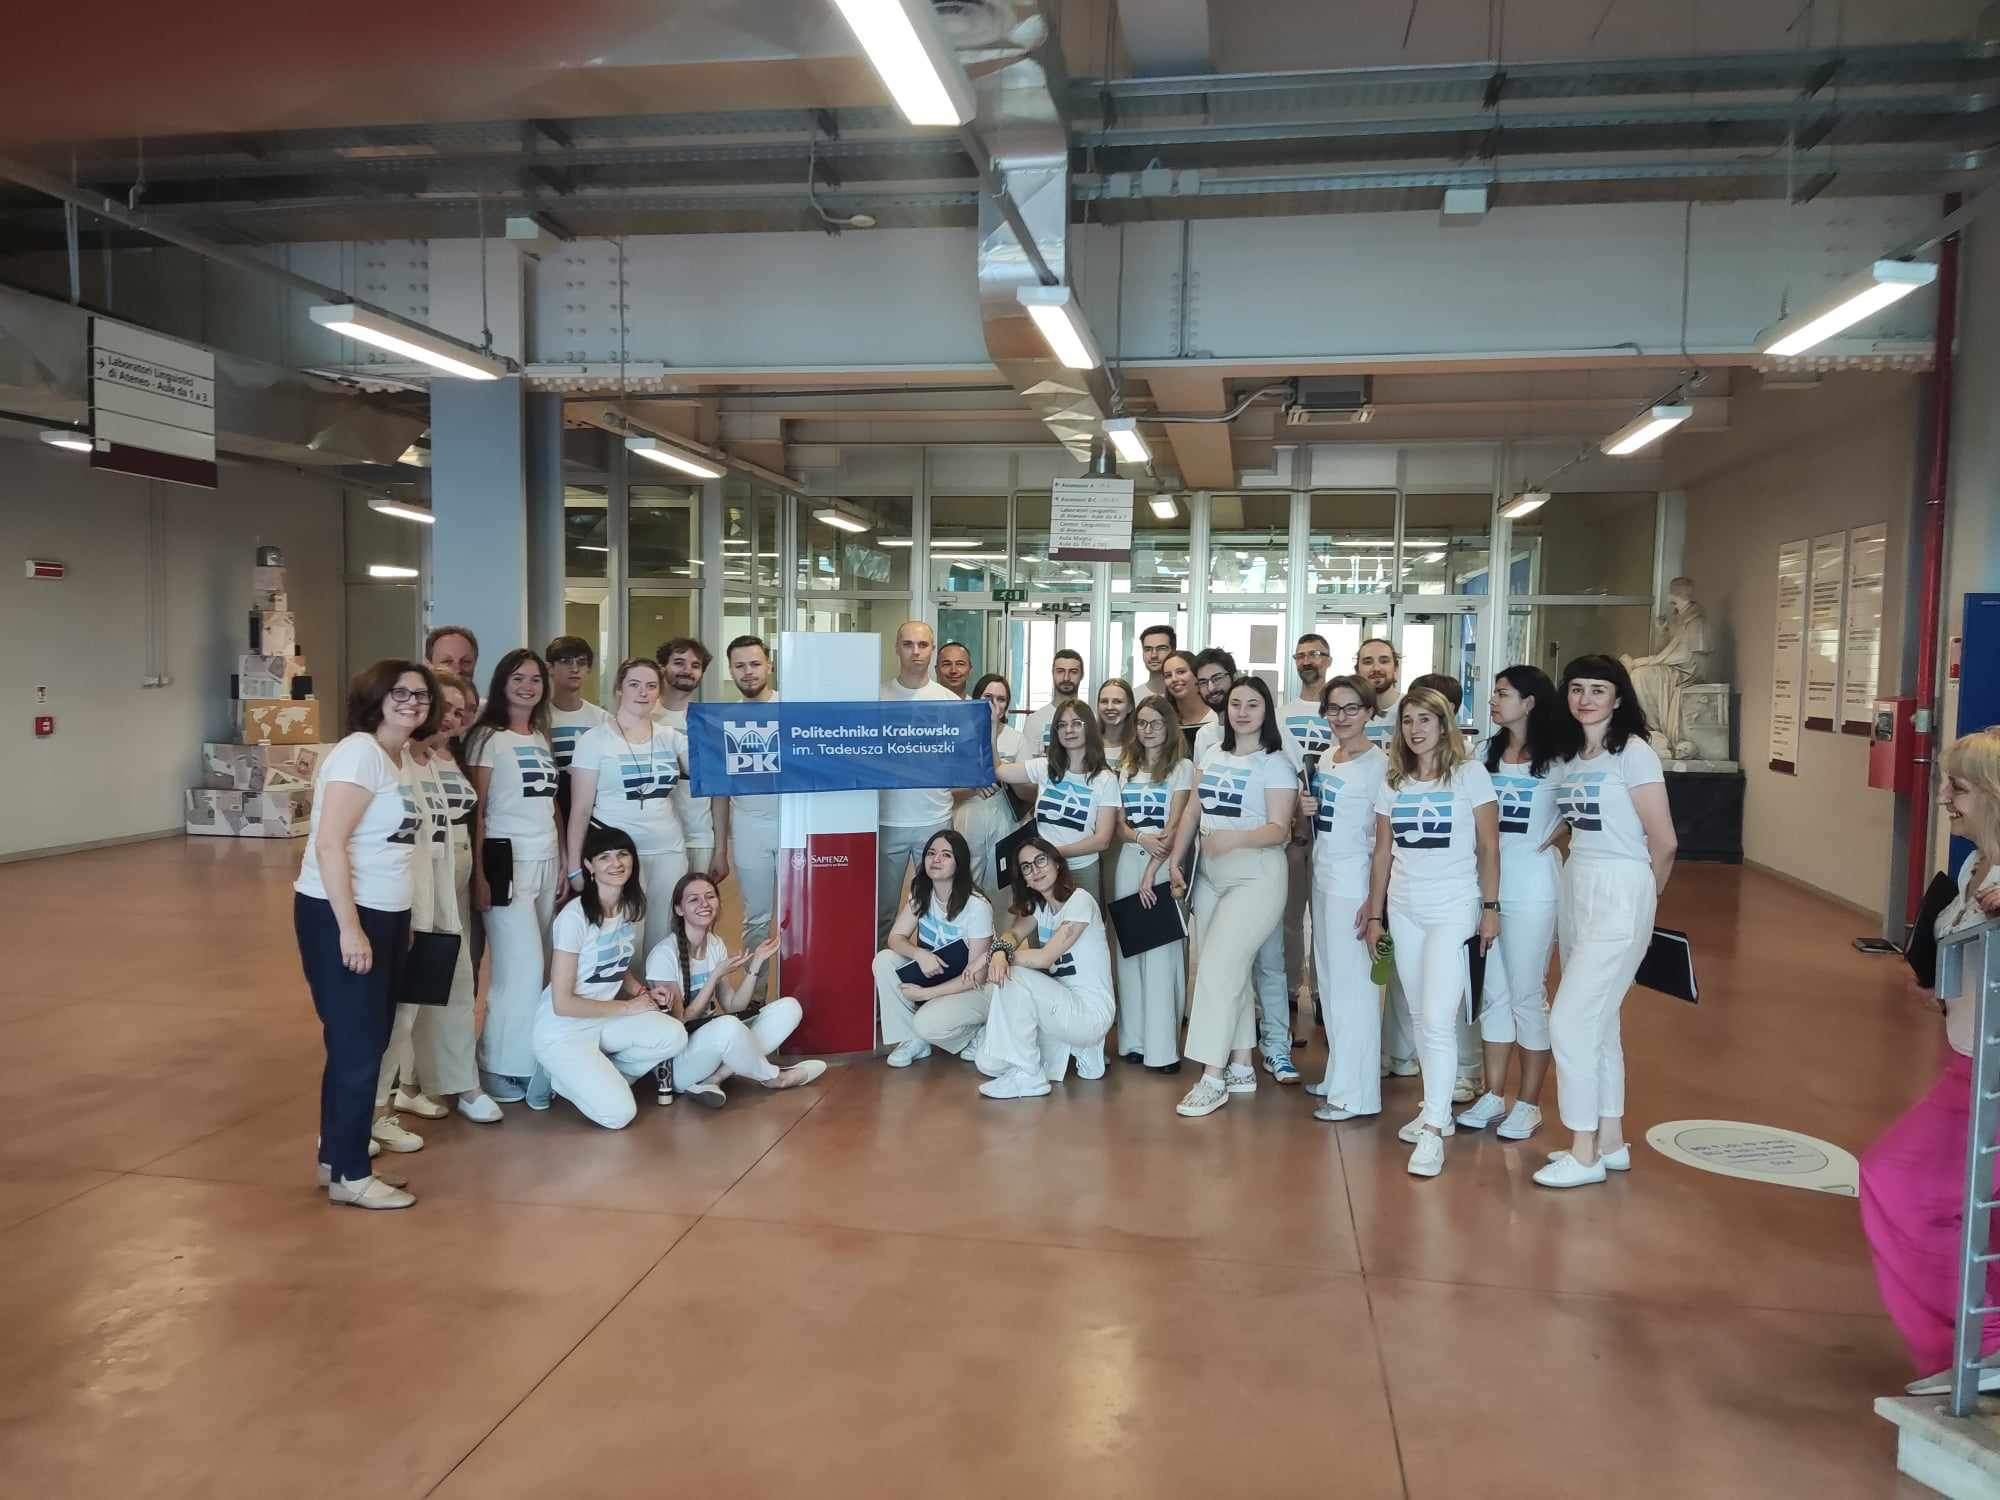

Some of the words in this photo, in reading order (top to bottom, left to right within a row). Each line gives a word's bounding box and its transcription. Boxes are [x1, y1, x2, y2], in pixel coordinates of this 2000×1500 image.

[791, 726, 879, 739] Politechnika
[882, 724, 960, 737] Krakowska
[792, 743, 815, 756] im.
[817, 743, 883, 755] Tadeusza
[887, 741, 955, 754] Kościuszki
[728, 753, 780, 772] PK
